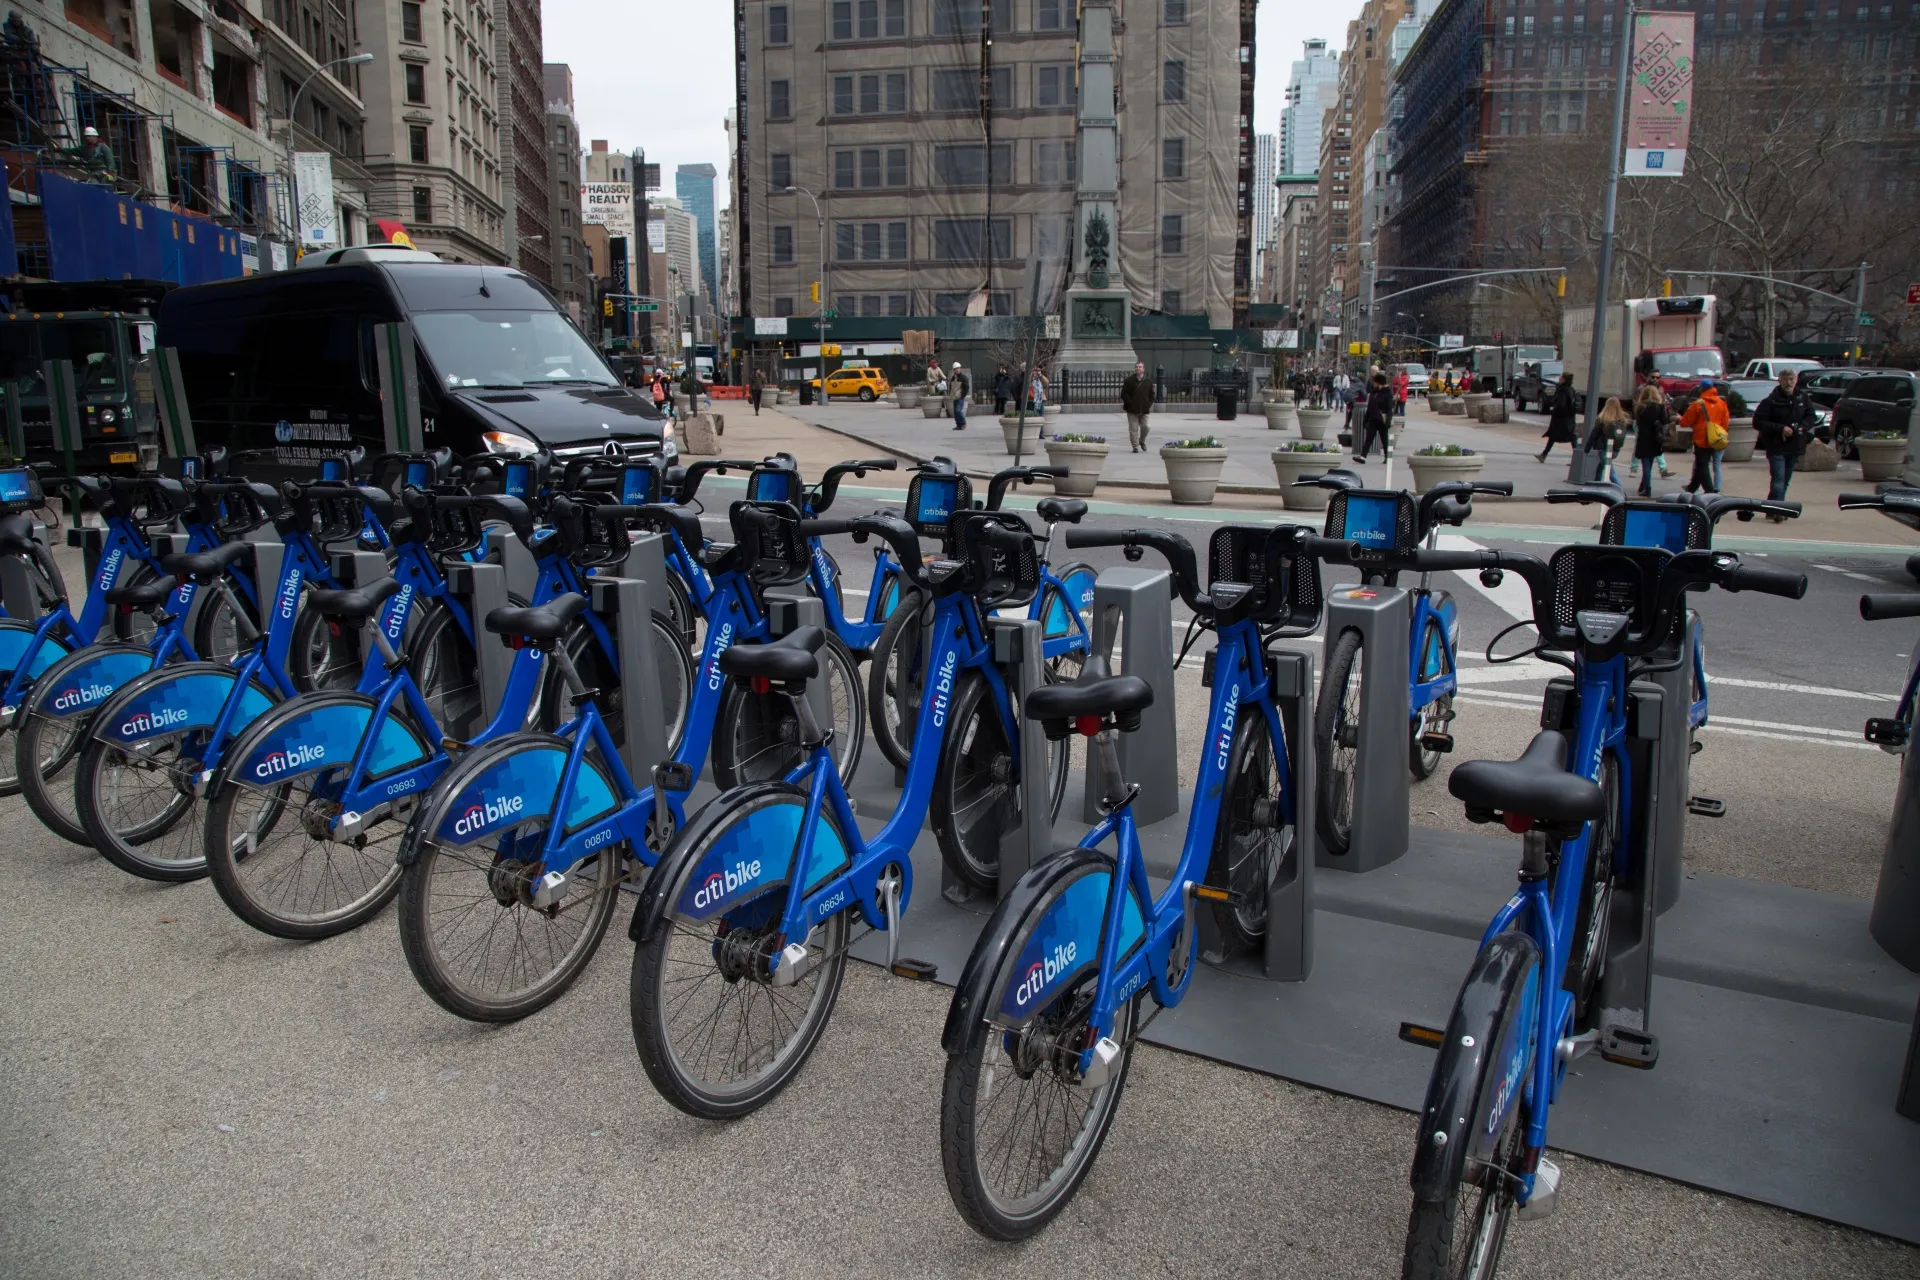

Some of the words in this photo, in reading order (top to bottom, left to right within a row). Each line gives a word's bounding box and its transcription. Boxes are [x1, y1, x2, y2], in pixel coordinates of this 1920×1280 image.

[1658, 65, 1692, 99] EATS
[588, 184, 630, 194] HADSON
[589, 194, 630, 204] REALTY
[607, 213, 625, 221] SPACE
[424, 418, 435, 433] 21
[275, 446, 292, 458] TOLL
[293, 447, 309, 459] FREE
[387, 778, 416, 795] 03693
[584, 829, 612, 849] 00870
[819, 890, 845, 915] 06634
[1119, 971, 1141, 1001] 07791
